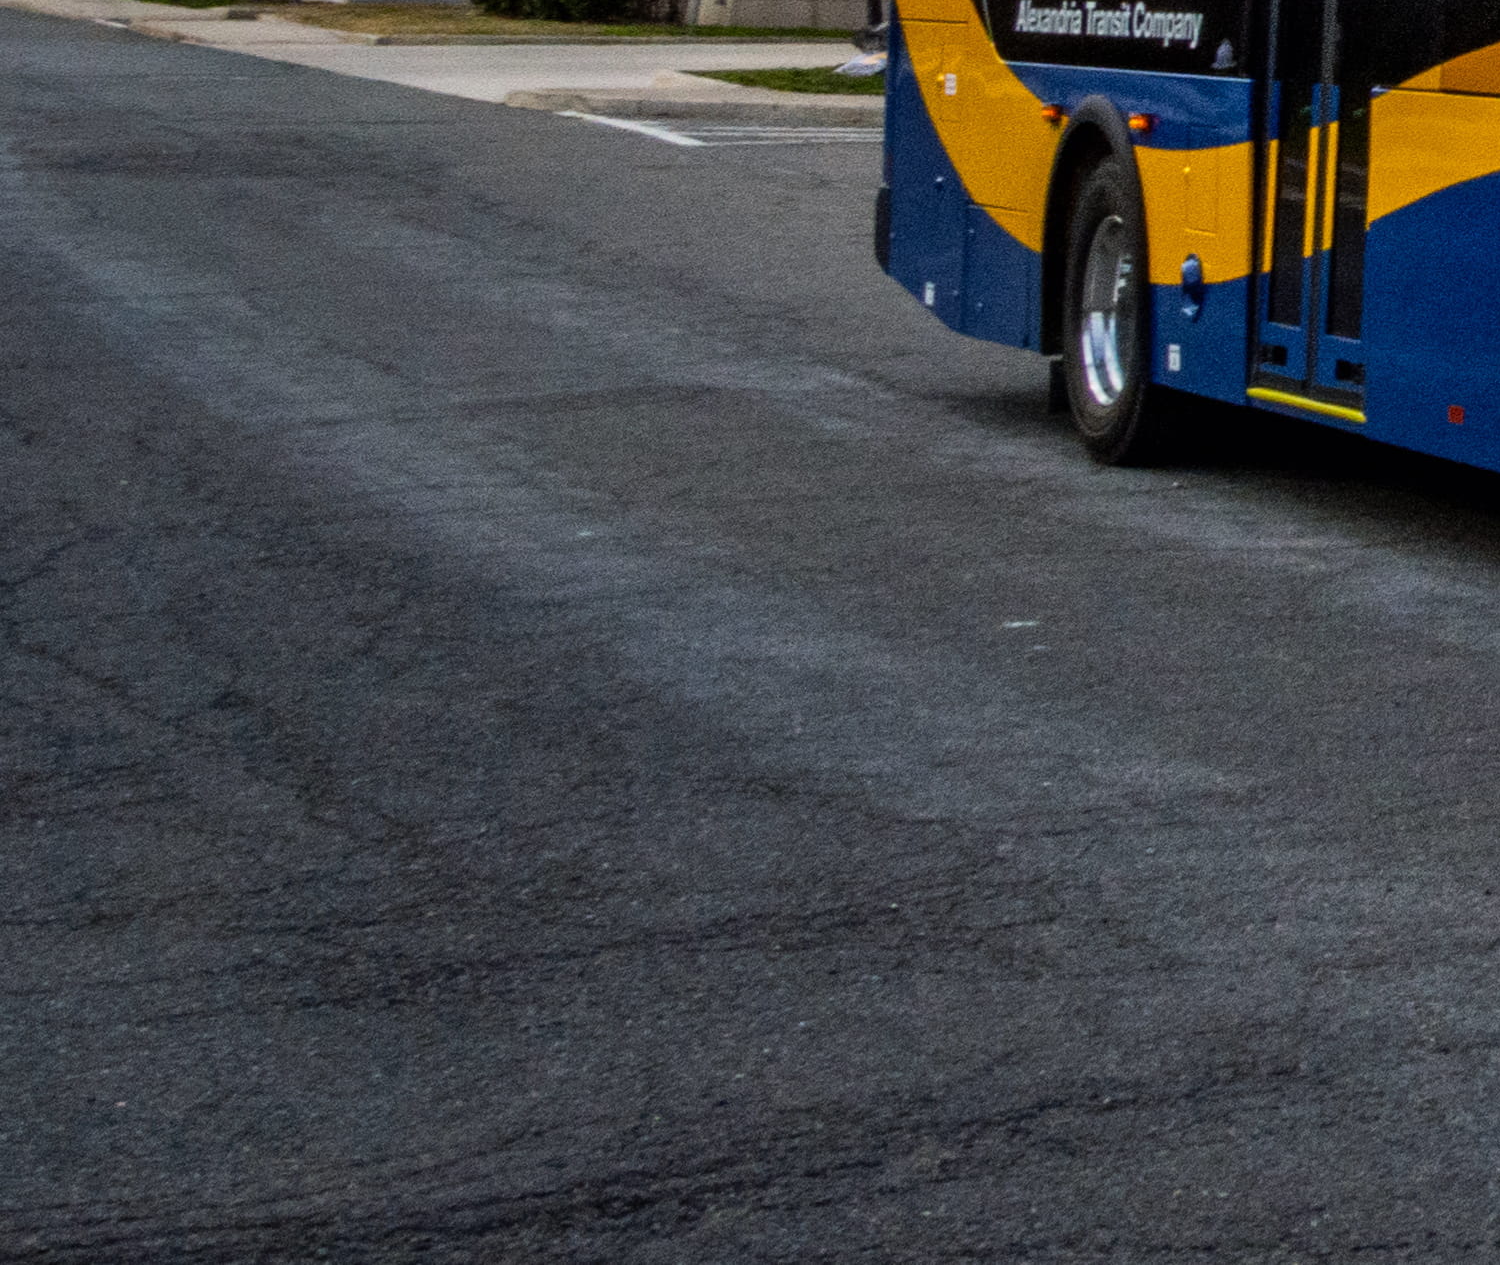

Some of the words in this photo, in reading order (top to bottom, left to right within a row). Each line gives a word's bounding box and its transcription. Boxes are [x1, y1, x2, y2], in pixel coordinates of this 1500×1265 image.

[1015, 0, 1082, 35] Alexandria
[1086, 1, 1131, 37] Transit
[1133, 1, 1204, 49] Company
